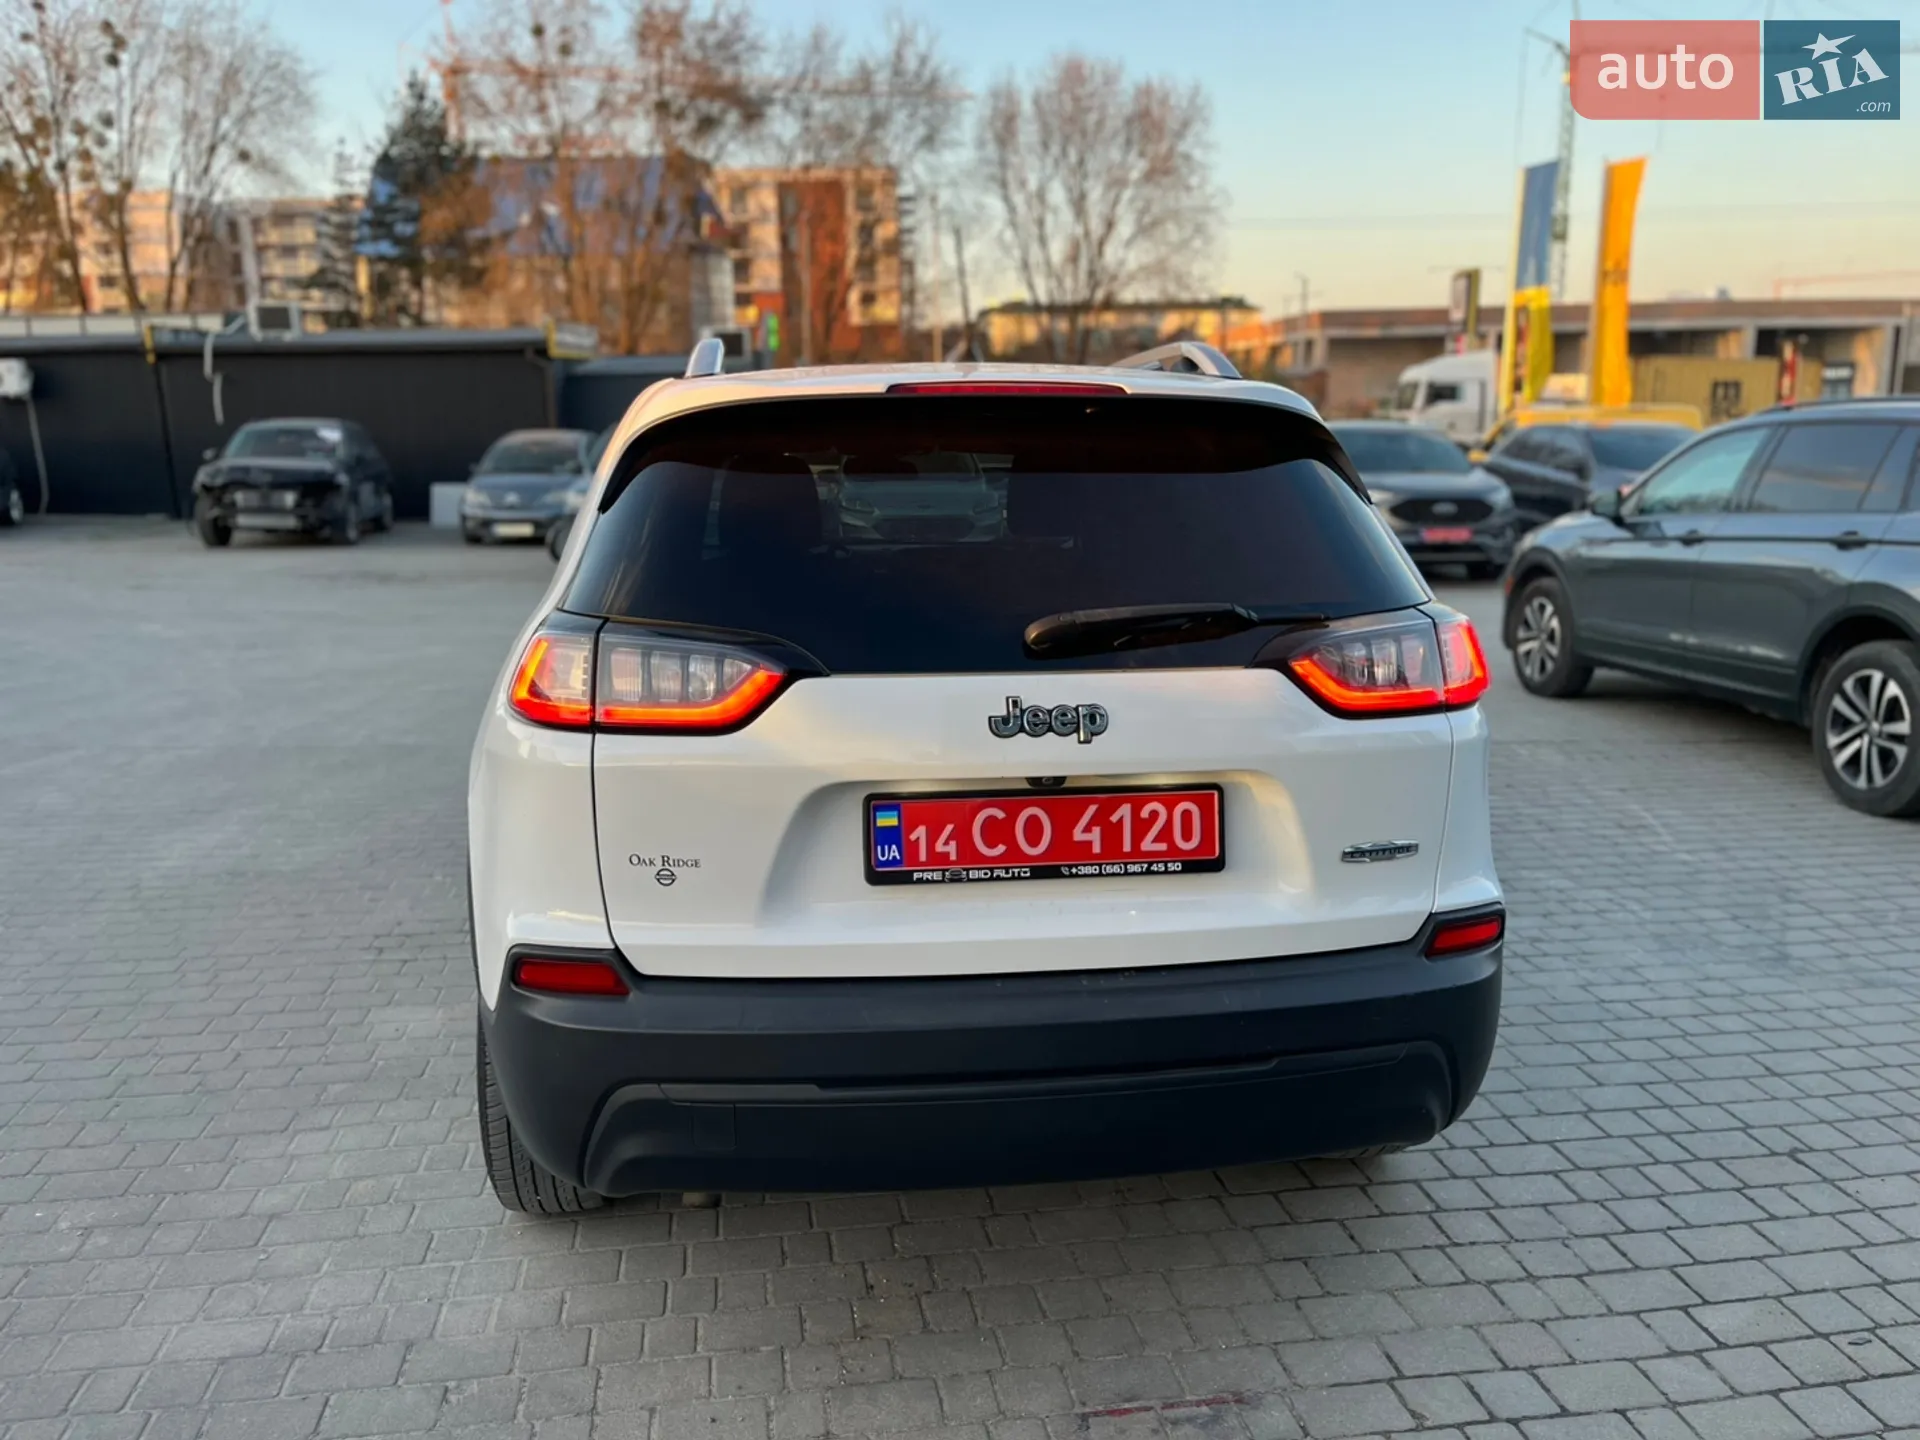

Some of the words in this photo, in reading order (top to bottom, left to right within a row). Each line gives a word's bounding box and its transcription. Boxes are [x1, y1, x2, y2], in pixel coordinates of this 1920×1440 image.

[988, 696, 1109, 744] Jeep
[877, 846, 900, 861] UA
[909, 824, 957, 862] 14
[971, 806, 1052, 857] CO
[1072, 801, 1202, 854] 4120
[913, 871, 943, 881] PRE
[969, 869, 991, 879] BID
[993, 868, 1031, 878] AUTO
[1070, 865, 1100, 875] +380
[1126, 863, 1149, 873] 967
[1150, 862, 1165, 872] 45
[1167, 862, 1182, 871] 50
